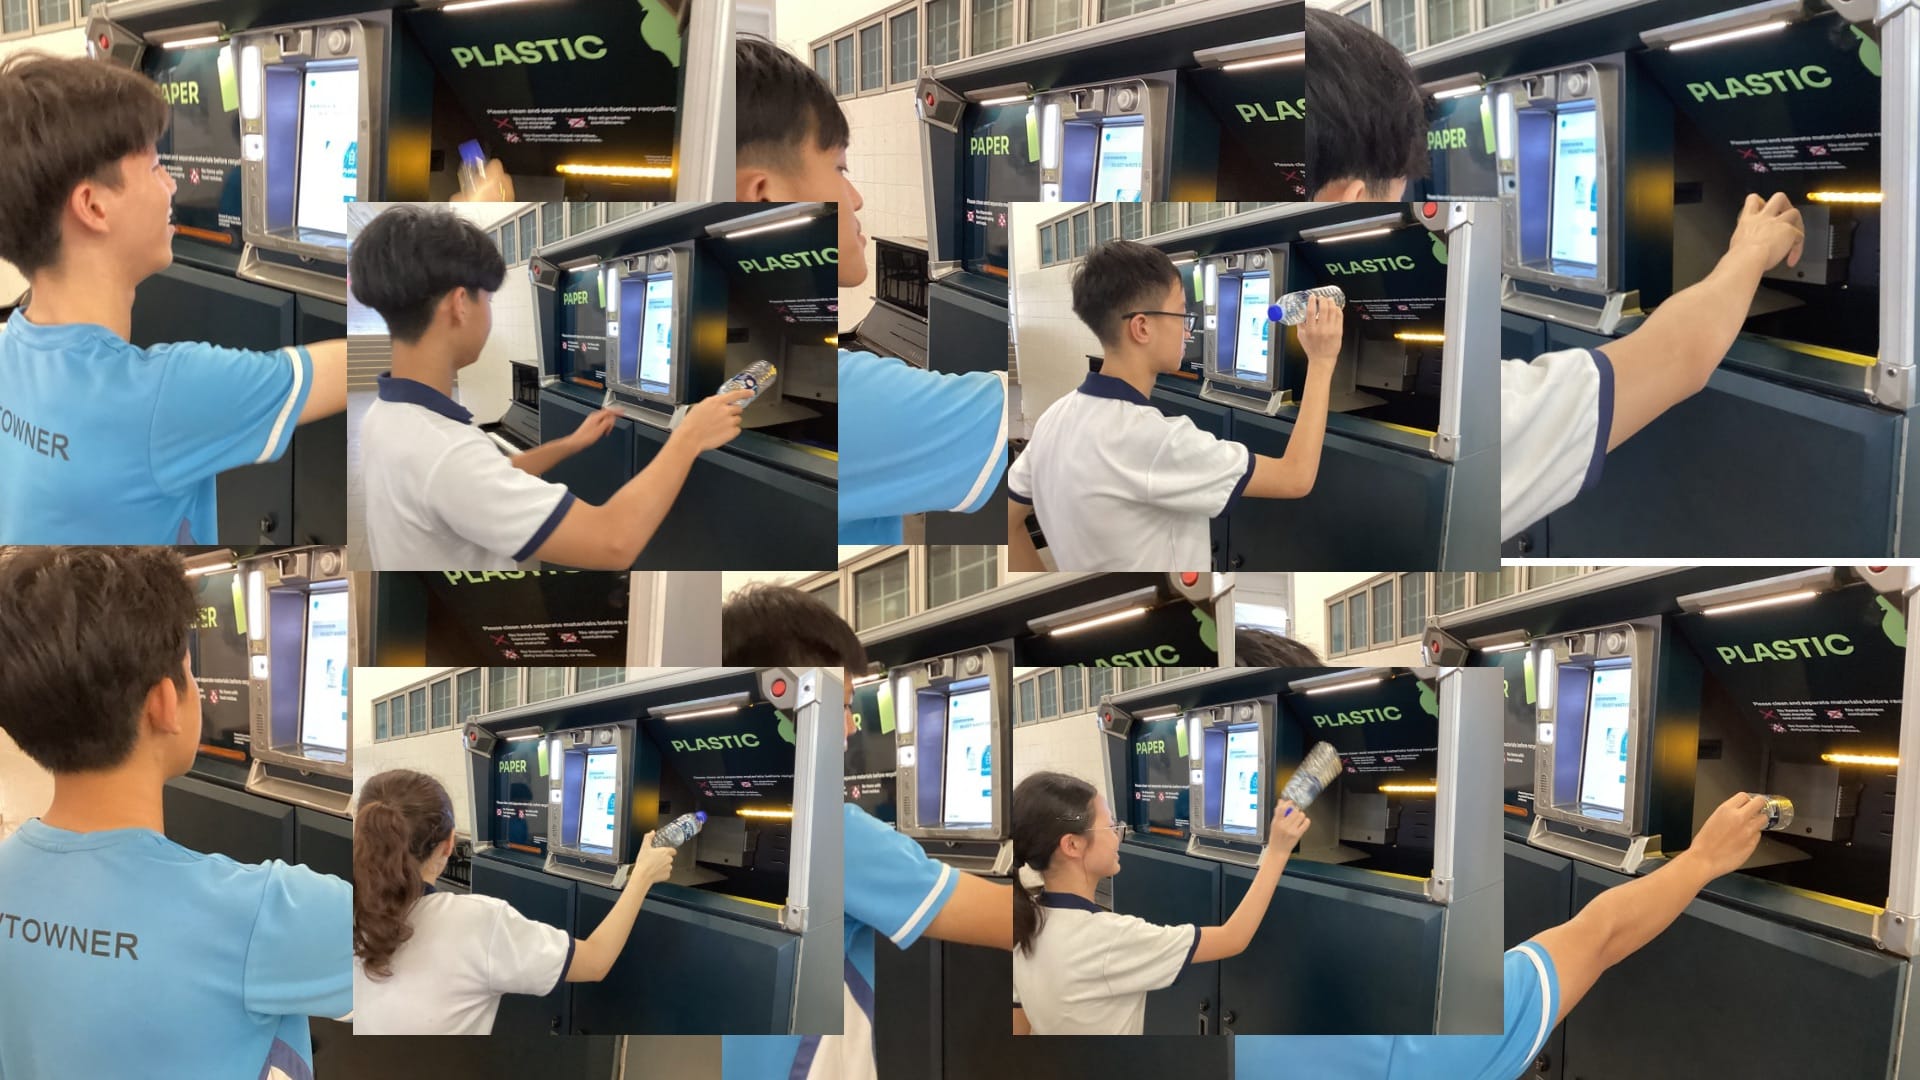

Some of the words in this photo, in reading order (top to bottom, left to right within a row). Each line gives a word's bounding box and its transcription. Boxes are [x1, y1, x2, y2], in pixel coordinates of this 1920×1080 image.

[451, 34, 607, 68] PLASTIC
[157, 80, 200, 105] APER
[1686, 65, 1833, 102] PLASTIC
[970, 135, 1010, 156] PAPER
[1427, 127, 1467, 150] PAPER
[738, 247, 838, 273] PLASTIC
[1325, 255, 1416, 276] PLASTIC
[563, 290, 588, 306] PAPER
[0, 405, 70, 461] OWNER
[1063, 644, 1180, 668] ASTIC
[1716, 633, 1855, 665] PLASTIC
[1312, 706, 1402, 728] PLASTIC
[671, 733, 761, 753] PLASTIC
[1136, 740, 1165, 755] PAPER
[499, 759, 527, 773] PAPER
[0, 912, 139, 961] TOWNER
